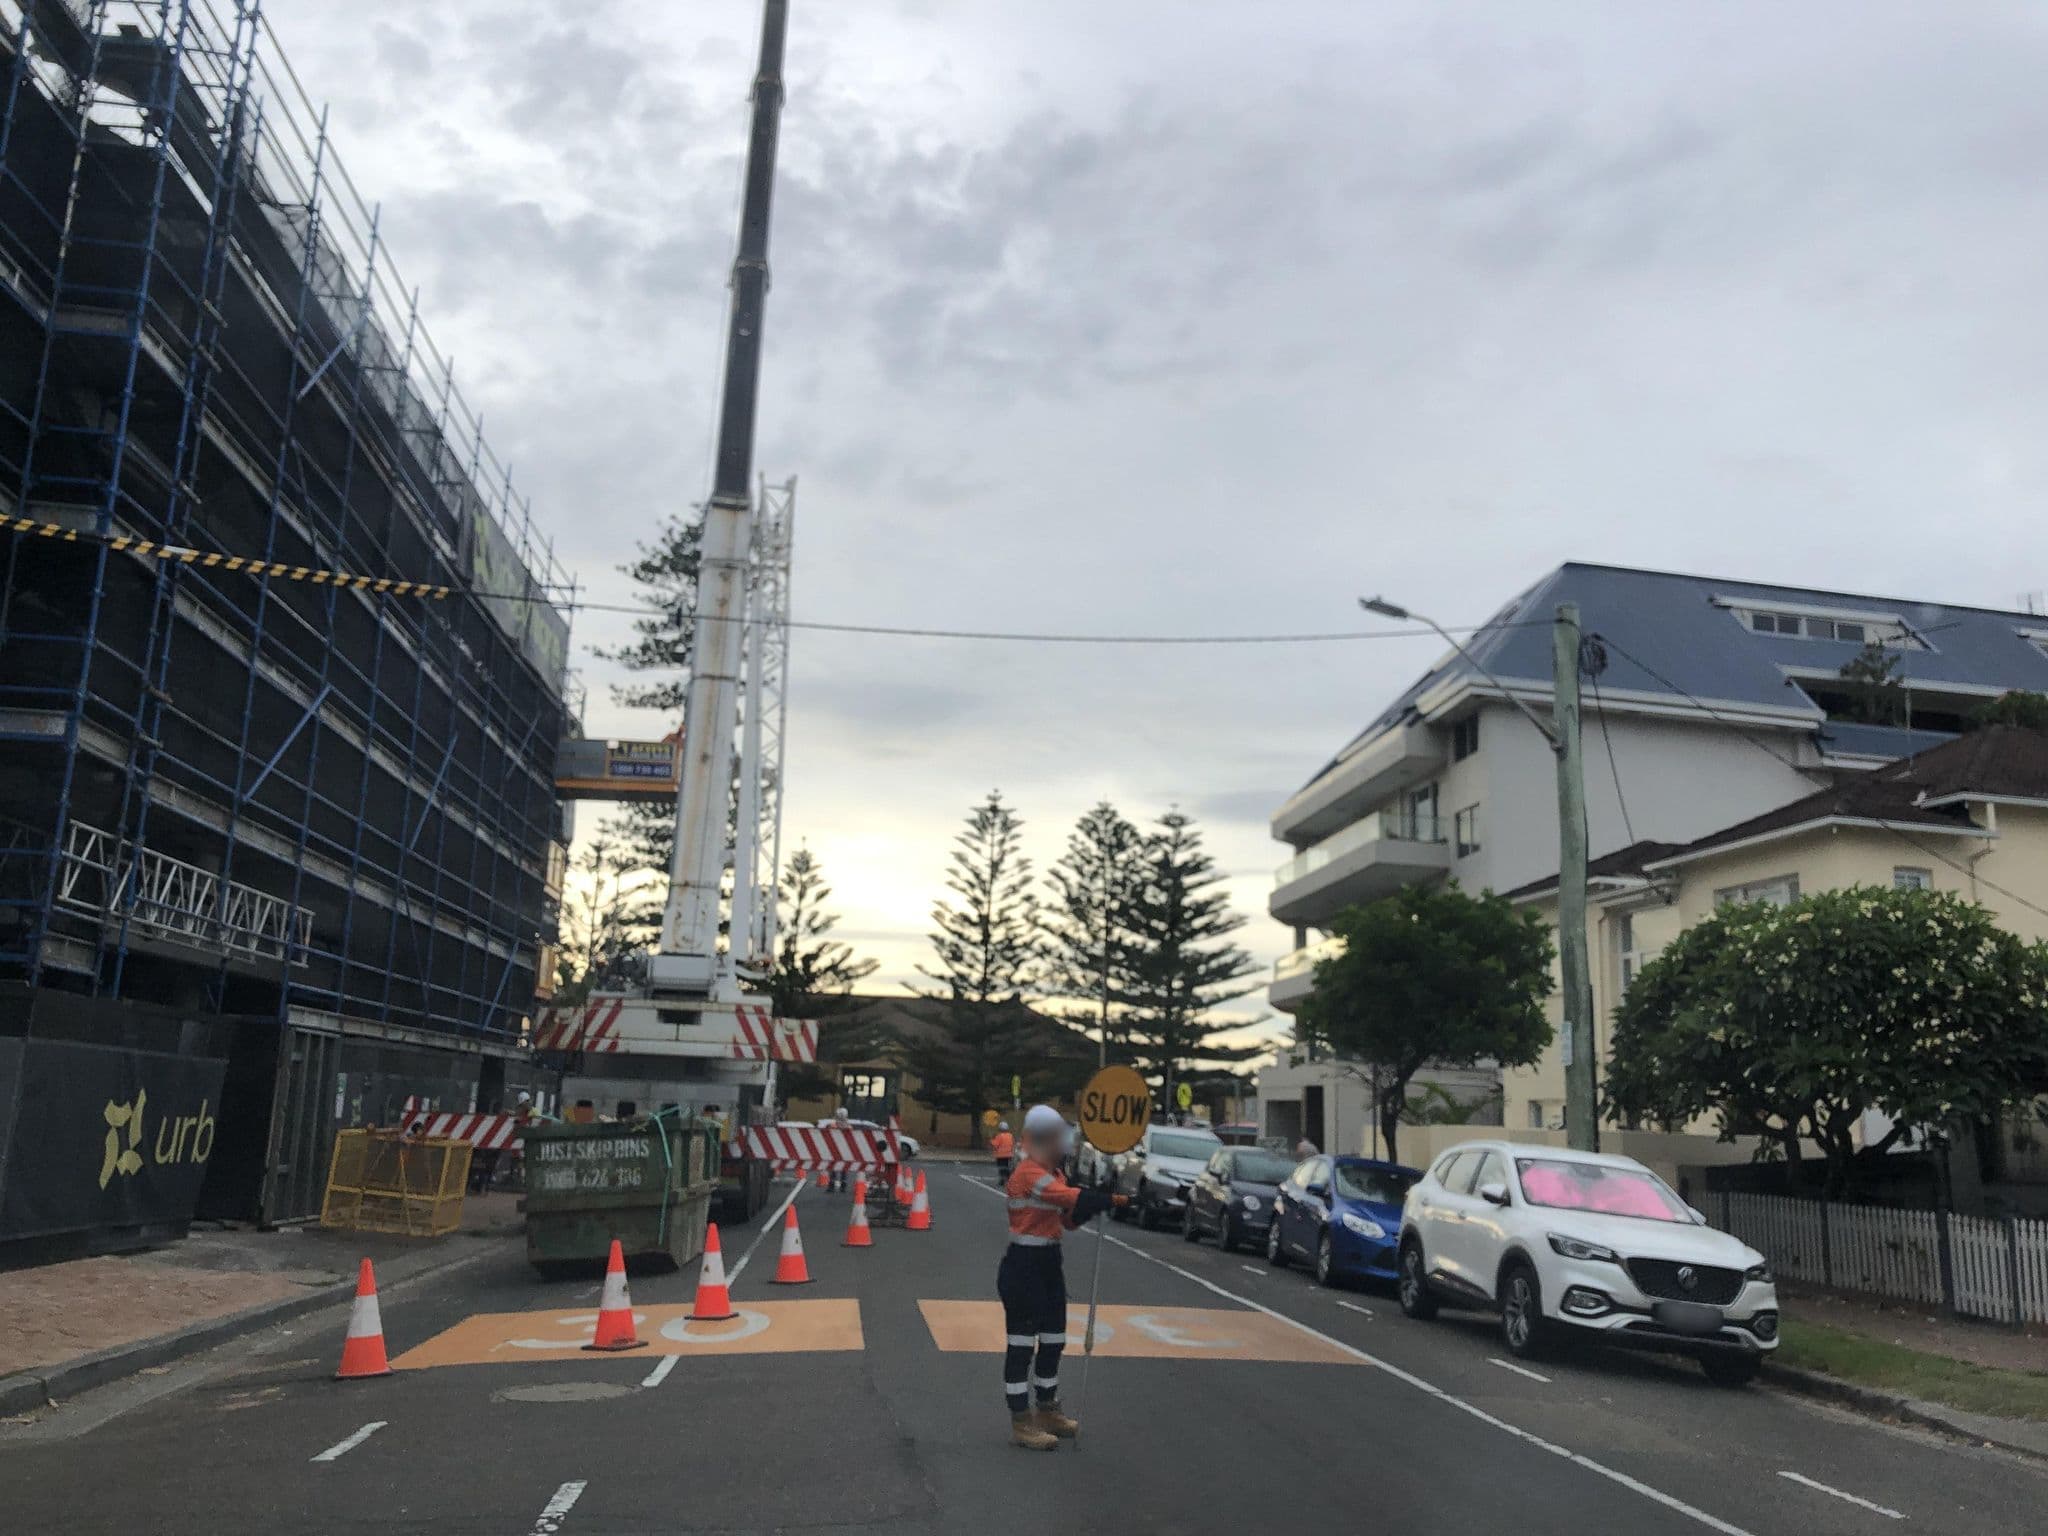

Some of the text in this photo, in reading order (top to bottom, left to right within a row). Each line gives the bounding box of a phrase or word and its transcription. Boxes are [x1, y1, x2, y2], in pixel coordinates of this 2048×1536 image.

[1083, 1092, 1147, 1126] SLOW
[155, 1098, 214, 1164] urb
[535, 1138, 649, 1161] JUST SKIP BINS
